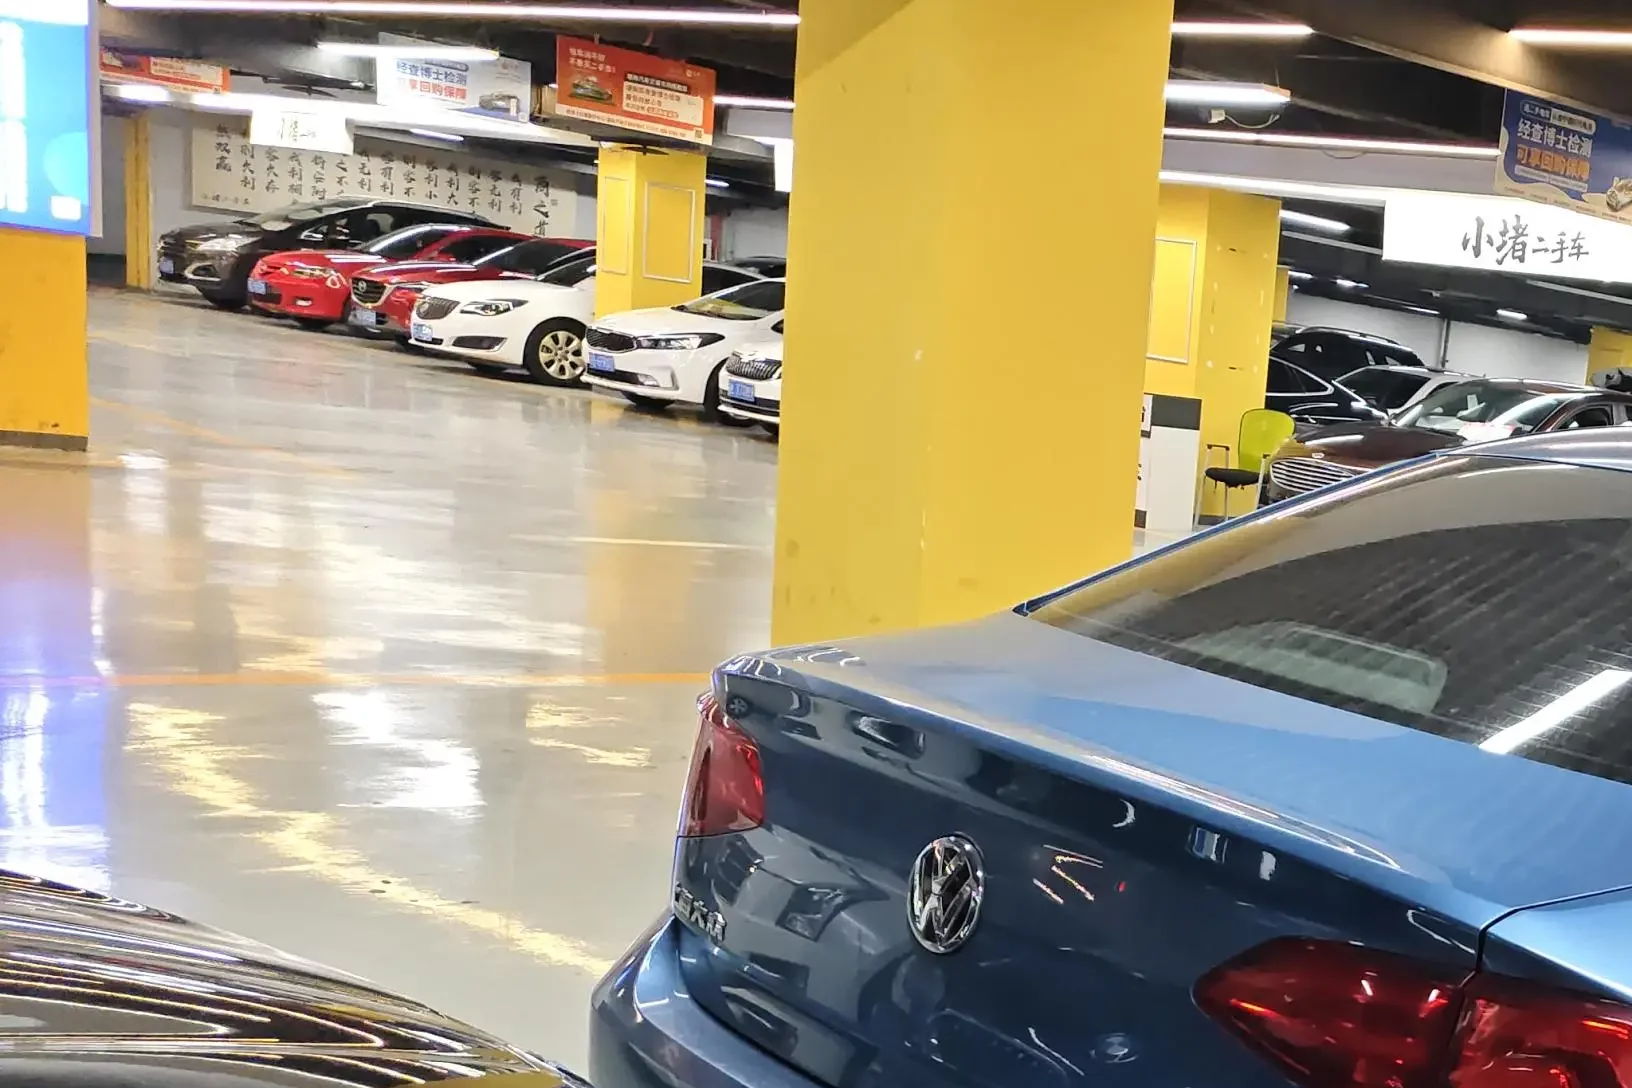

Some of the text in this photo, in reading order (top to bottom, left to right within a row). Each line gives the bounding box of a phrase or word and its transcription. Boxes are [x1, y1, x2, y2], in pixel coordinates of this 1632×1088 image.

[1517, 118, 1593, 158] 经查博士检测
[1516, 144, 1592, 182] 可享回购保障
[1462, 214, 1589, 265] 小堵二手车
